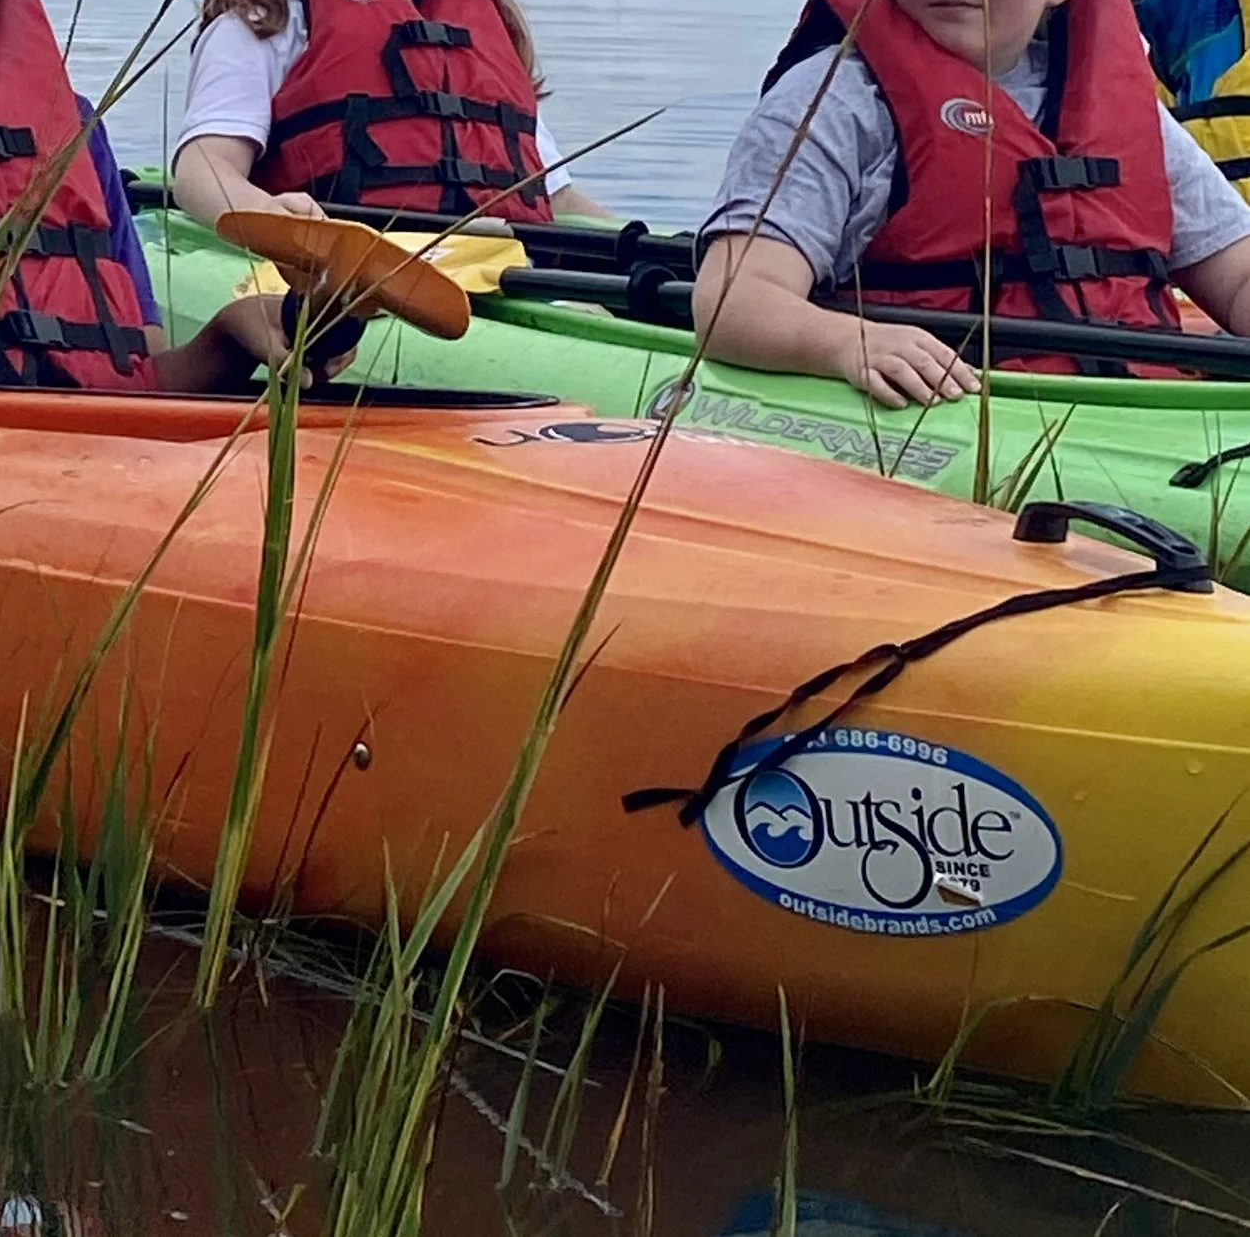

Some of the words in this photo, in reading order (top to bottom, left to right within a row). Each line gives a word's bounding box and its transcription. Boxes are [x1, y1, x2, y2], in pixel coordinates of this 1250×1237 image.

[690, 394, 959, 470] WILDERNESS
[834, 729, 949, 765] 686-6996
[734, 767, 1016, 910] Outside
[935, 860, 991, 878] SINCE
[779, 892, 998, 936] outsidebrands.com
